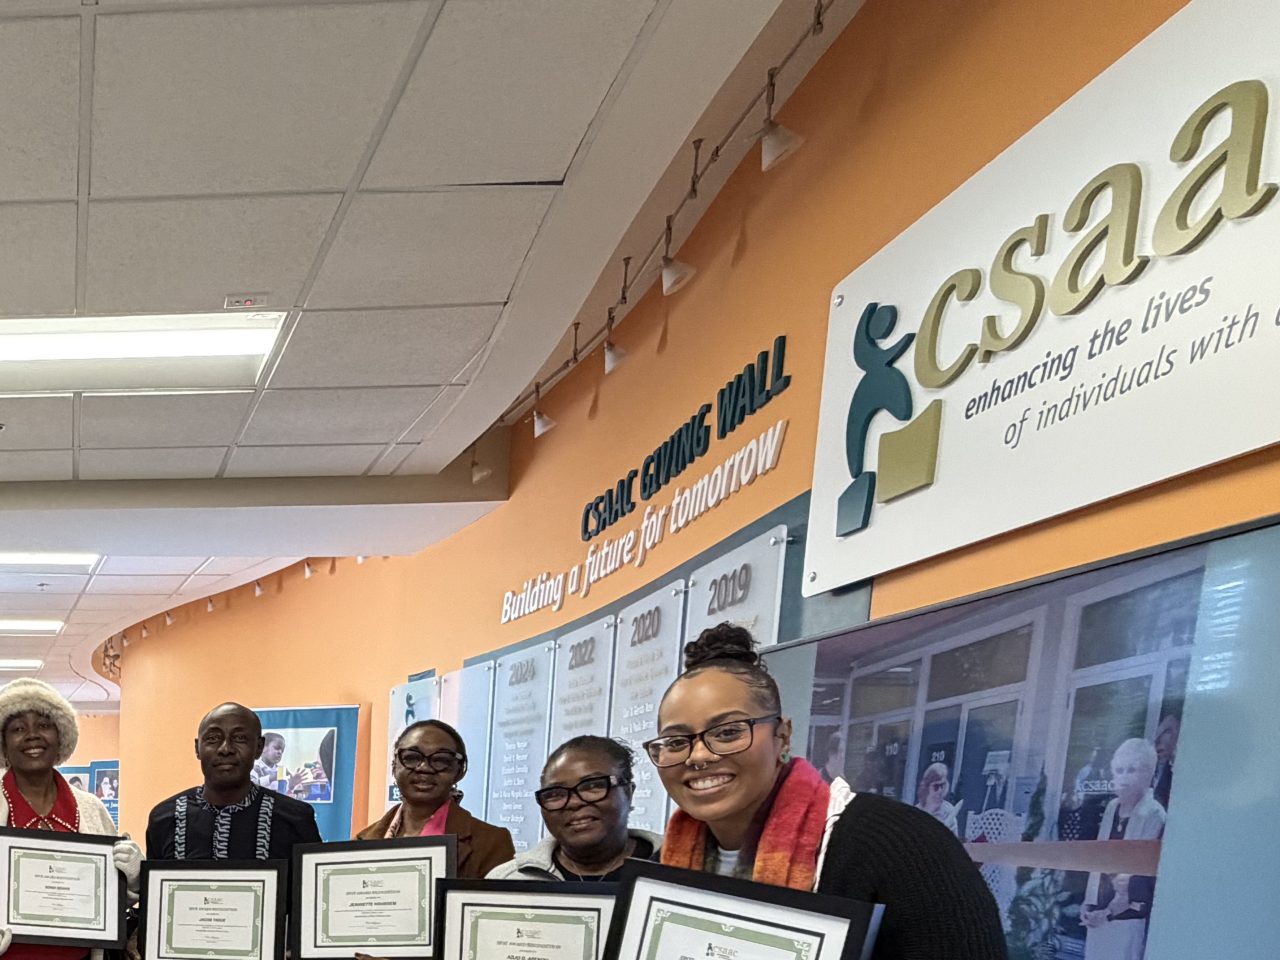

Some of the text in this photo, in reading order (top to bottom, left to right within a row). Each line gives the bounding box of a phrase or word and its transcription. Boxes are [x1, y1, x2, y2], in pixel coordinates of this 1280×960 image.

[964, 275, 1214, 420] enhancing the lives
[1003, 303, 1260, 450] of individuals with
[581, 335, 793, 542] CSAAC GIVING WALL
[500, 419, 790, 624] Building a future for tomorrow
[707, 562, 752, 616] 2019
[568, 636, 596, 670] 2022
[630, 605, 662, 648] 2020
